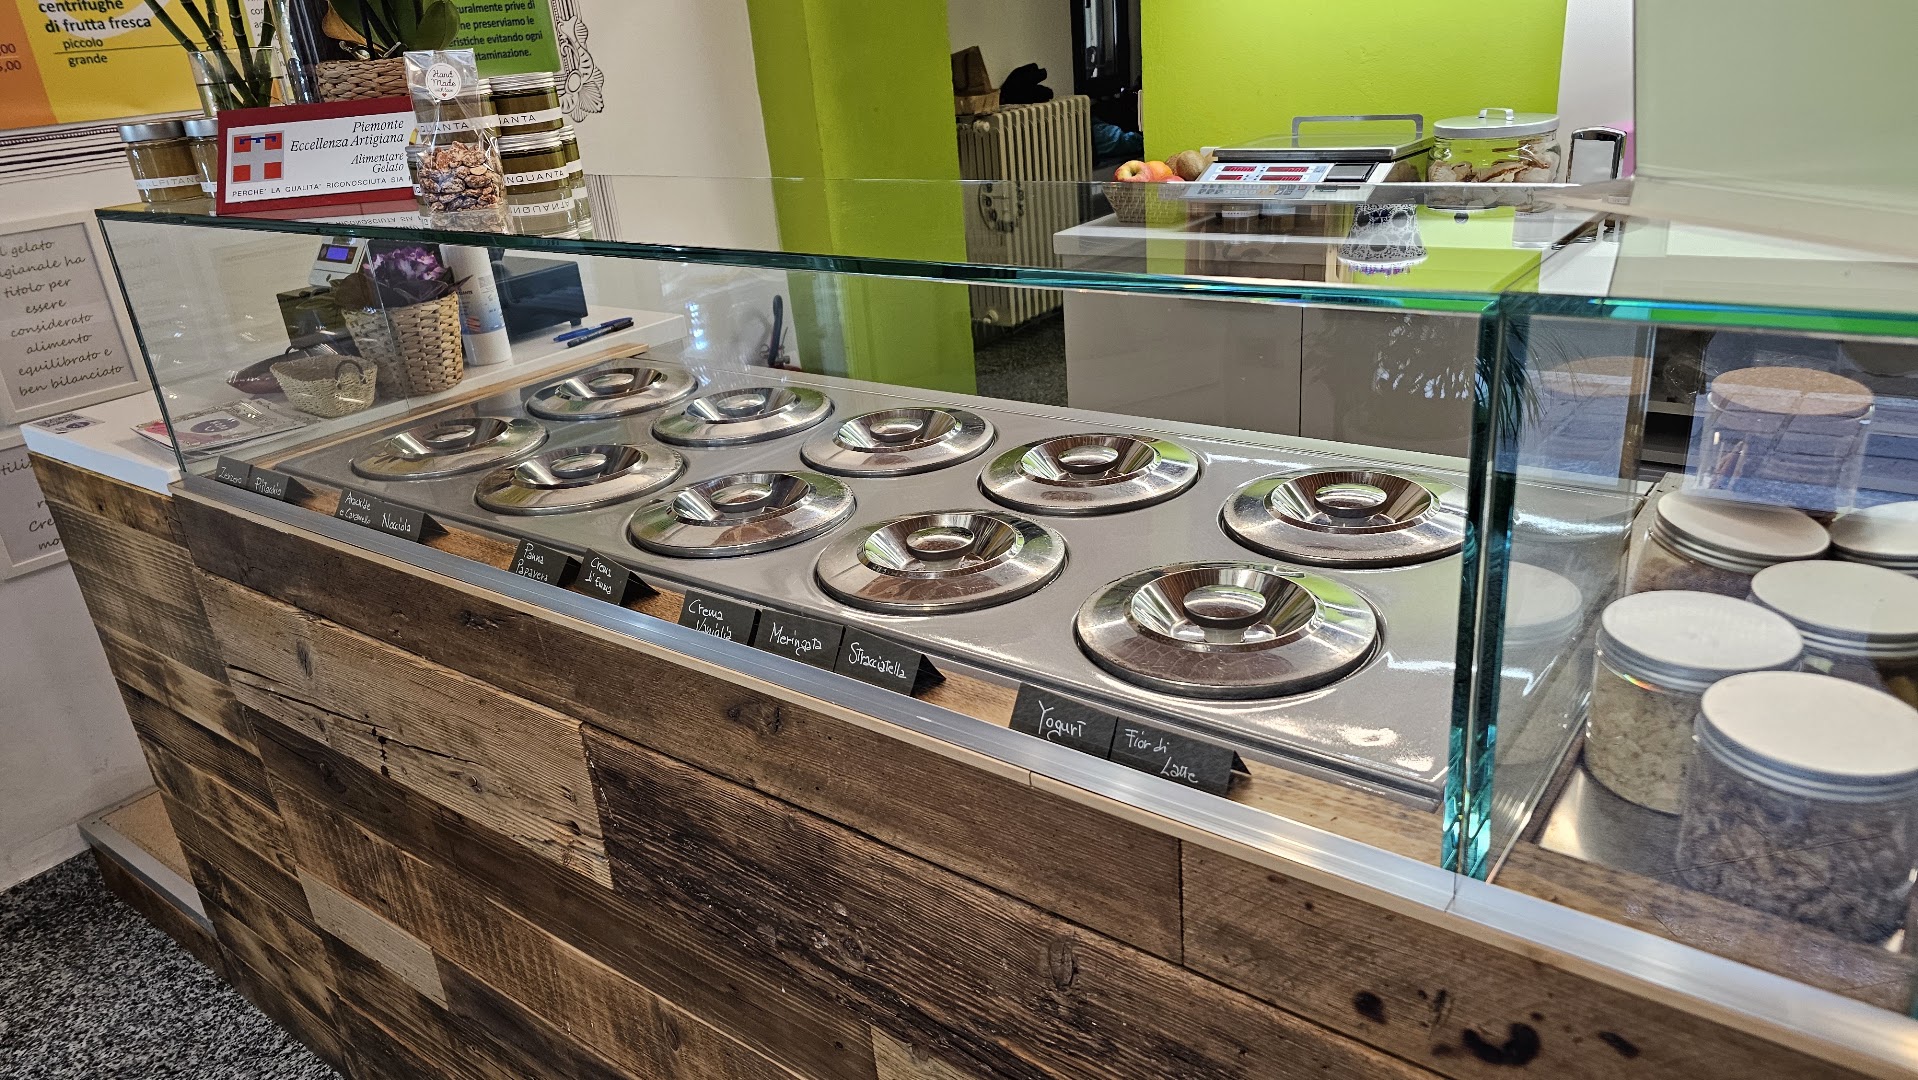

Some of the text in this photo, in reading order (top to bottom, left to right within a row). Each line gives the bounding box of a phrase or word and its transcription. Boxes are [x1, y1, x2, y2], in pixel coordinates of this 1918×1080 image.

[38, 0, 124, 13] centrifughe
[456, 0, 536, 14] uralmente prive di
[45, 15, 152, 33] di frutta fresca
[473, 17, 526, 31] preserviamo
[526, 16, 535, 25] le
[63, 37, 104, 51] piccolo
[486, 32, 524, 44] evitando
[525, 31, 543, 42] ogni
[68, 53, 108, 68] grande
[352, 119, 404, 133] Piemonte
[290, 132, 404, 152] Eccellenza Artigiana
[351, 152, 404, 165] Alimentare
[372, 162, 404, 174] Gelato
[271, 187, 281, 195] LA
[326, 178, 387, 189] RICONOSCIUTA
[391, 176, 404, 184] SIA
[503, 170, 564, 184] NQUANTA
[11, 240, 55, 258] gelato
[64, 256, 86, 267] ha
[4, 279, 71, 298] titolo per
[25, 299, 66, 314] essere
[11, 313, 93, 338] considerato
[26, 333, 92, 354] alimento
[18, 348, 112, 377] equilibrato e
[19, 364, 124, 397] ben bilanciato
[218, 466, 242, 484] Zenzero
[381, 512, 411, 532] Nocciola
[523, 542, 545, 565] Panna
[590, 556, 612, 578] Crema
[688, 598, 724, 621] Crema
[769, 621, 822, 656] Meringata
[848, 641, 907, 679] Stracciatella
[1037, 700, 1087, 741] Yogurt
[1125, 728, 1170, 754] Fior di
[1160, 756, 1199, 784] Latte
